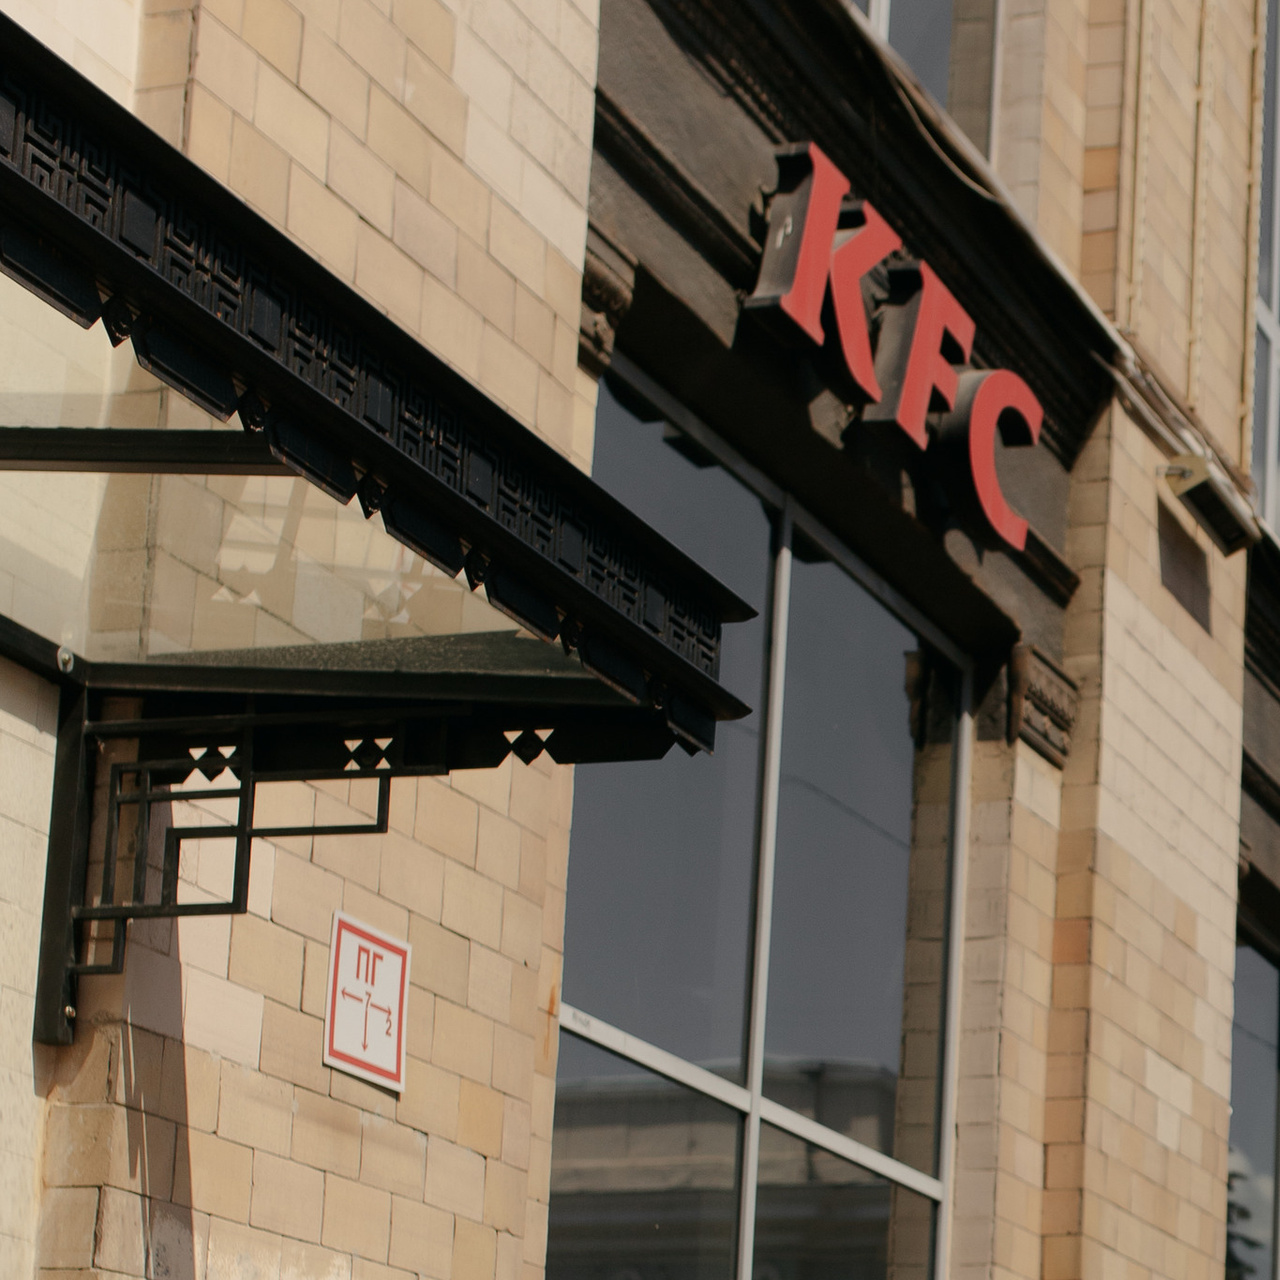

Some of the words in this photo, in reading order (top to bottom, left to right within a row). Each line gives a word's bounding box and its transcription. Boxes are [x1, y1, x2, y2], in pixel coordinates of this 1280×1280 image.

[780, 141, 1044, 552] KFC
[357, 945, 383, 986] ПГ
[386, 1017, 392, 1036] 2
